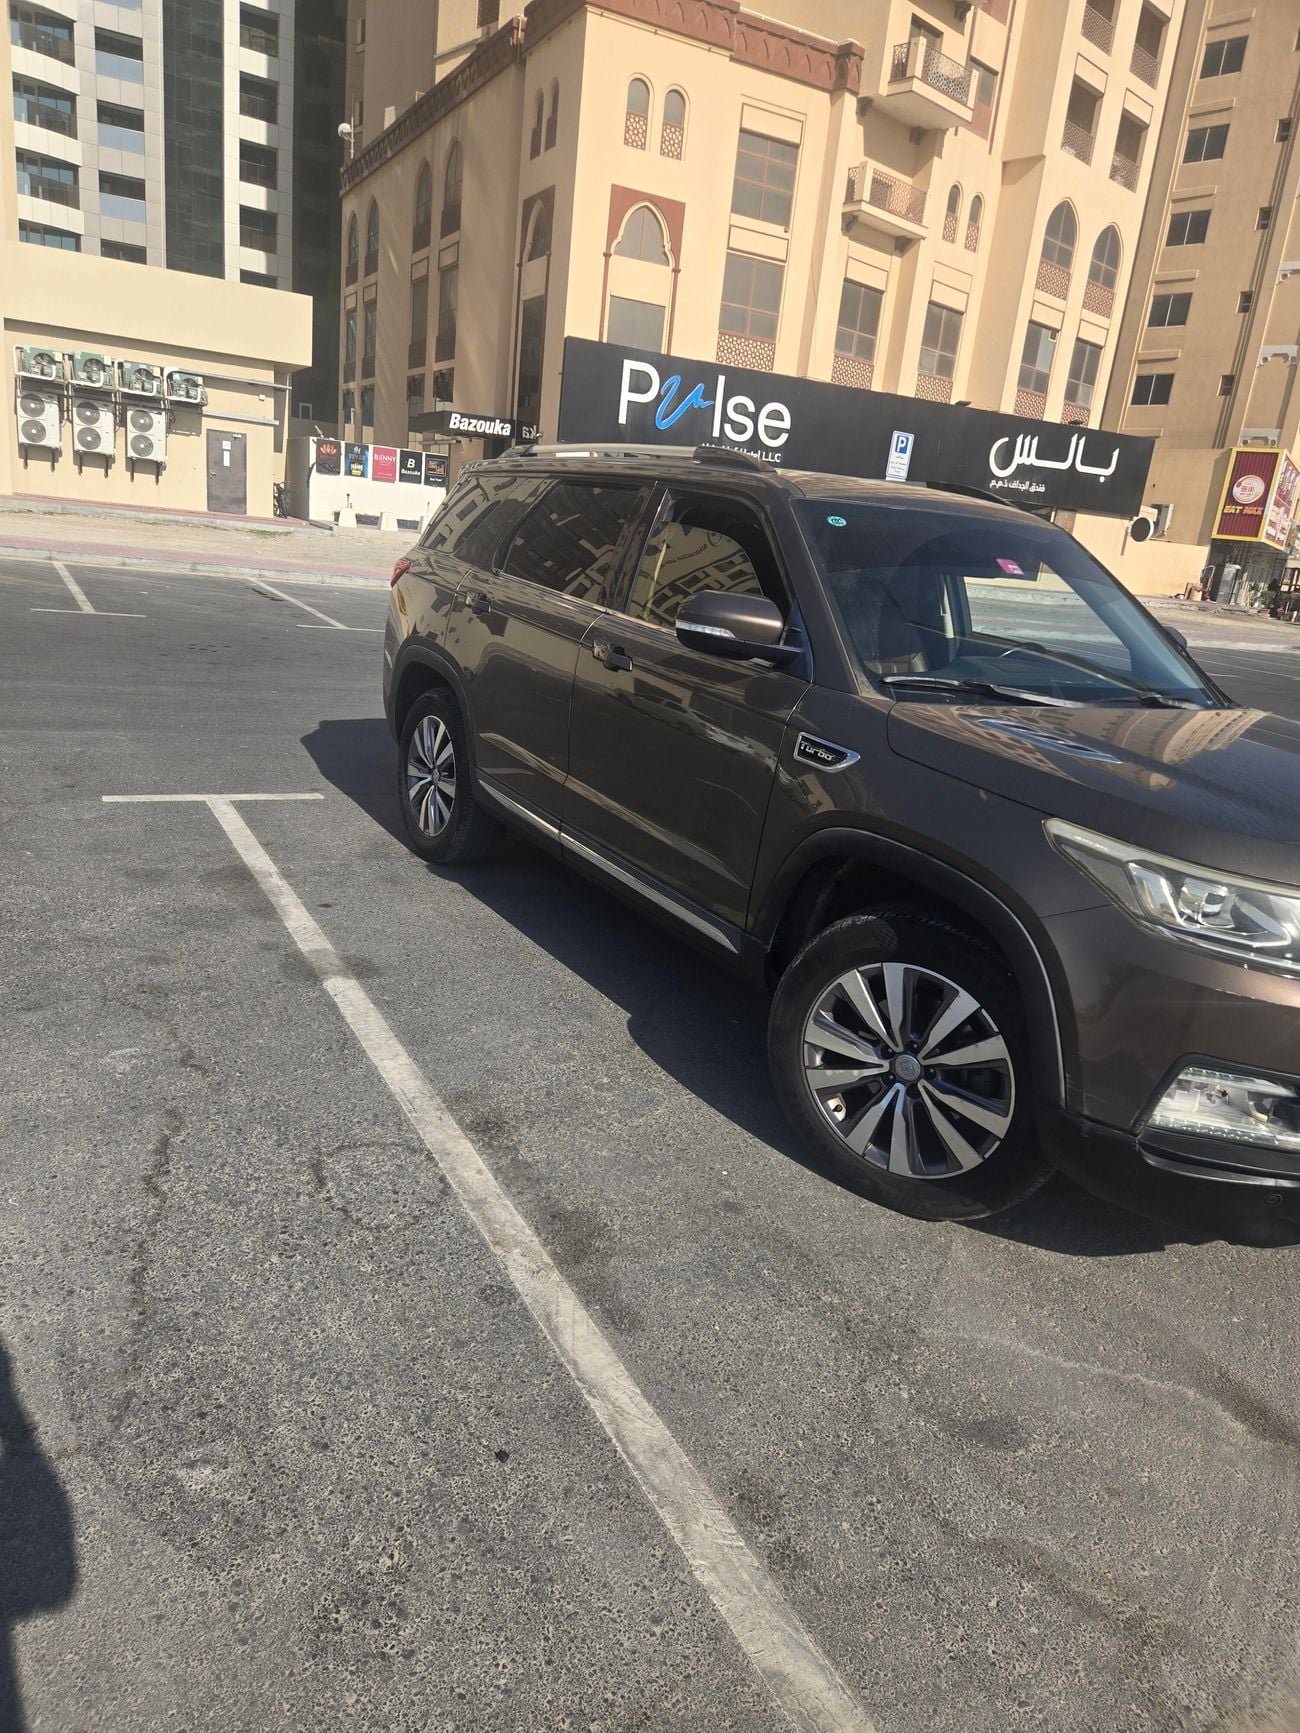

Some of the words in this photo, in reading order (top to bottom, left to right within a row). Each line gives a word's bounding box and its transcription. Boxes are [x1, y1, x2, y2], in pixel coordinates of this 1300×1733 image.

[618, 359, 791, 447] Pulse
[449, 413, 511, 436] Bazouka
[896, 436, 907, 452] P
[407, 458, 416, 468] B
[762, 451, 782, 463] LLC
[989, 433, 1120, 482] بالس
[401, 468, 421, 476] Bazouka
